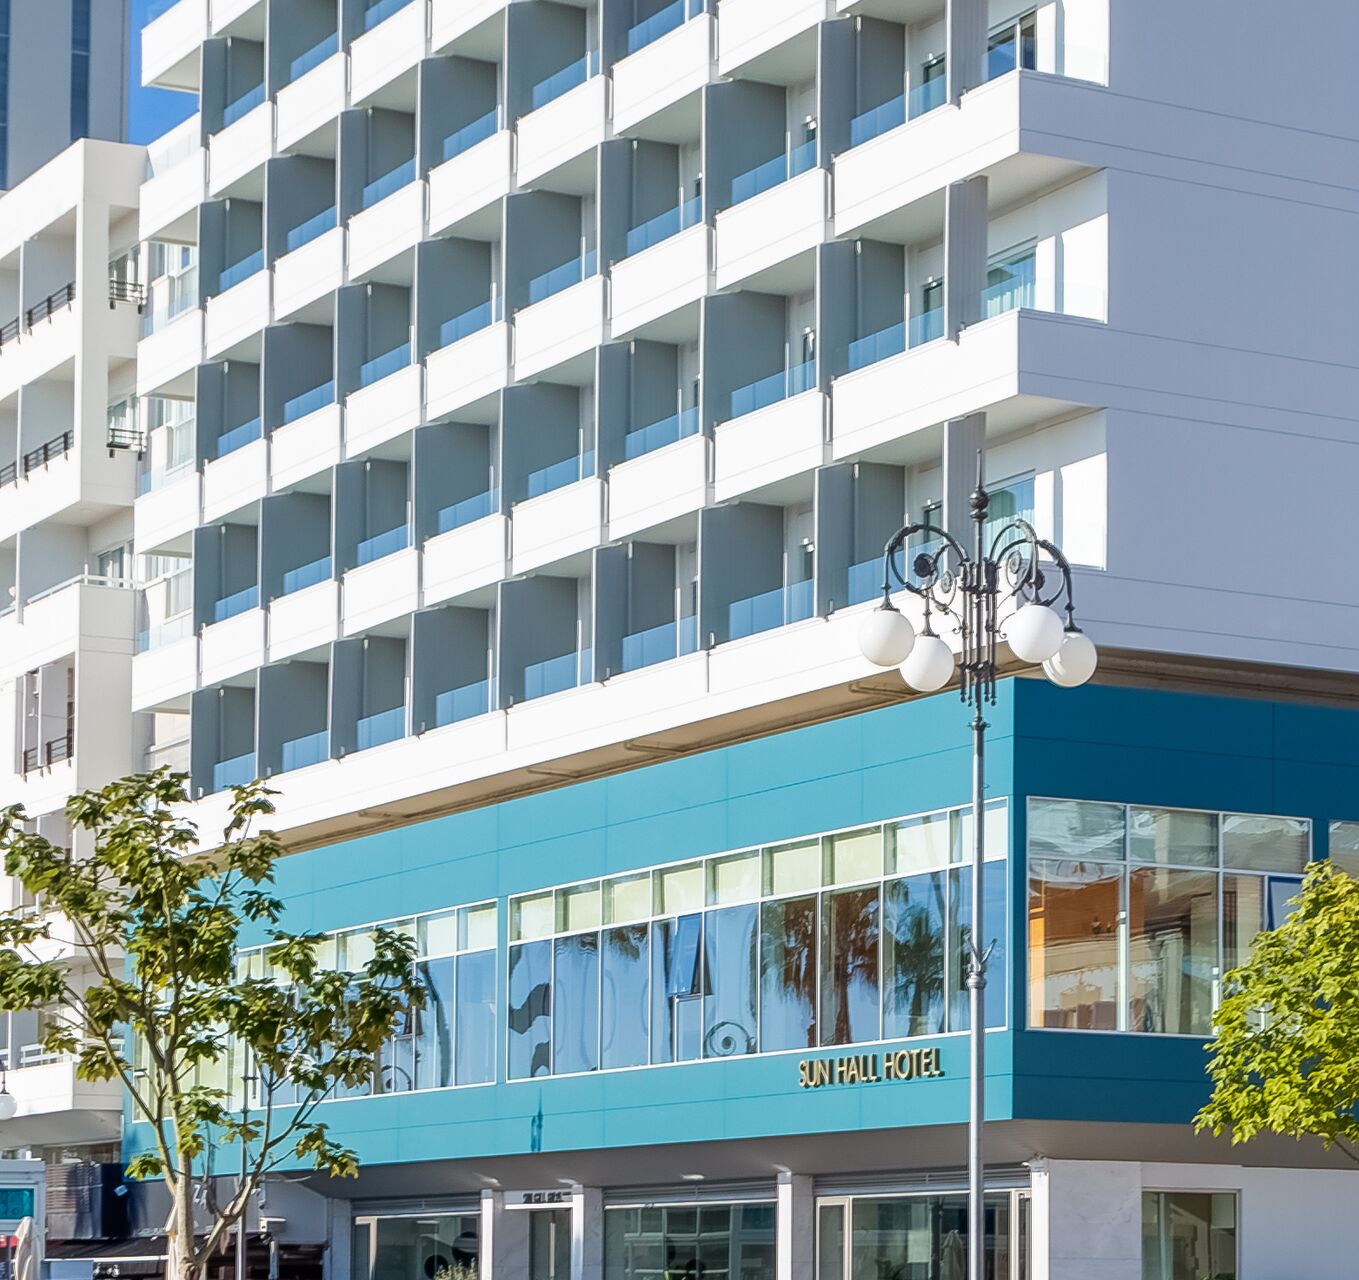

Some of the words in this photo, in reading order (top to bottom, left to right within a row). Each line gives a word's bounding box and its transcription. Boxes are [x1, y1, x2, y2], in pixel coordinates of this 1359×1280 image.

[799, 1059, 833, 1087] SUN
[837, 1054, 881, 1084] HALL
[884, 1048, 945, 1081] HOTEL
